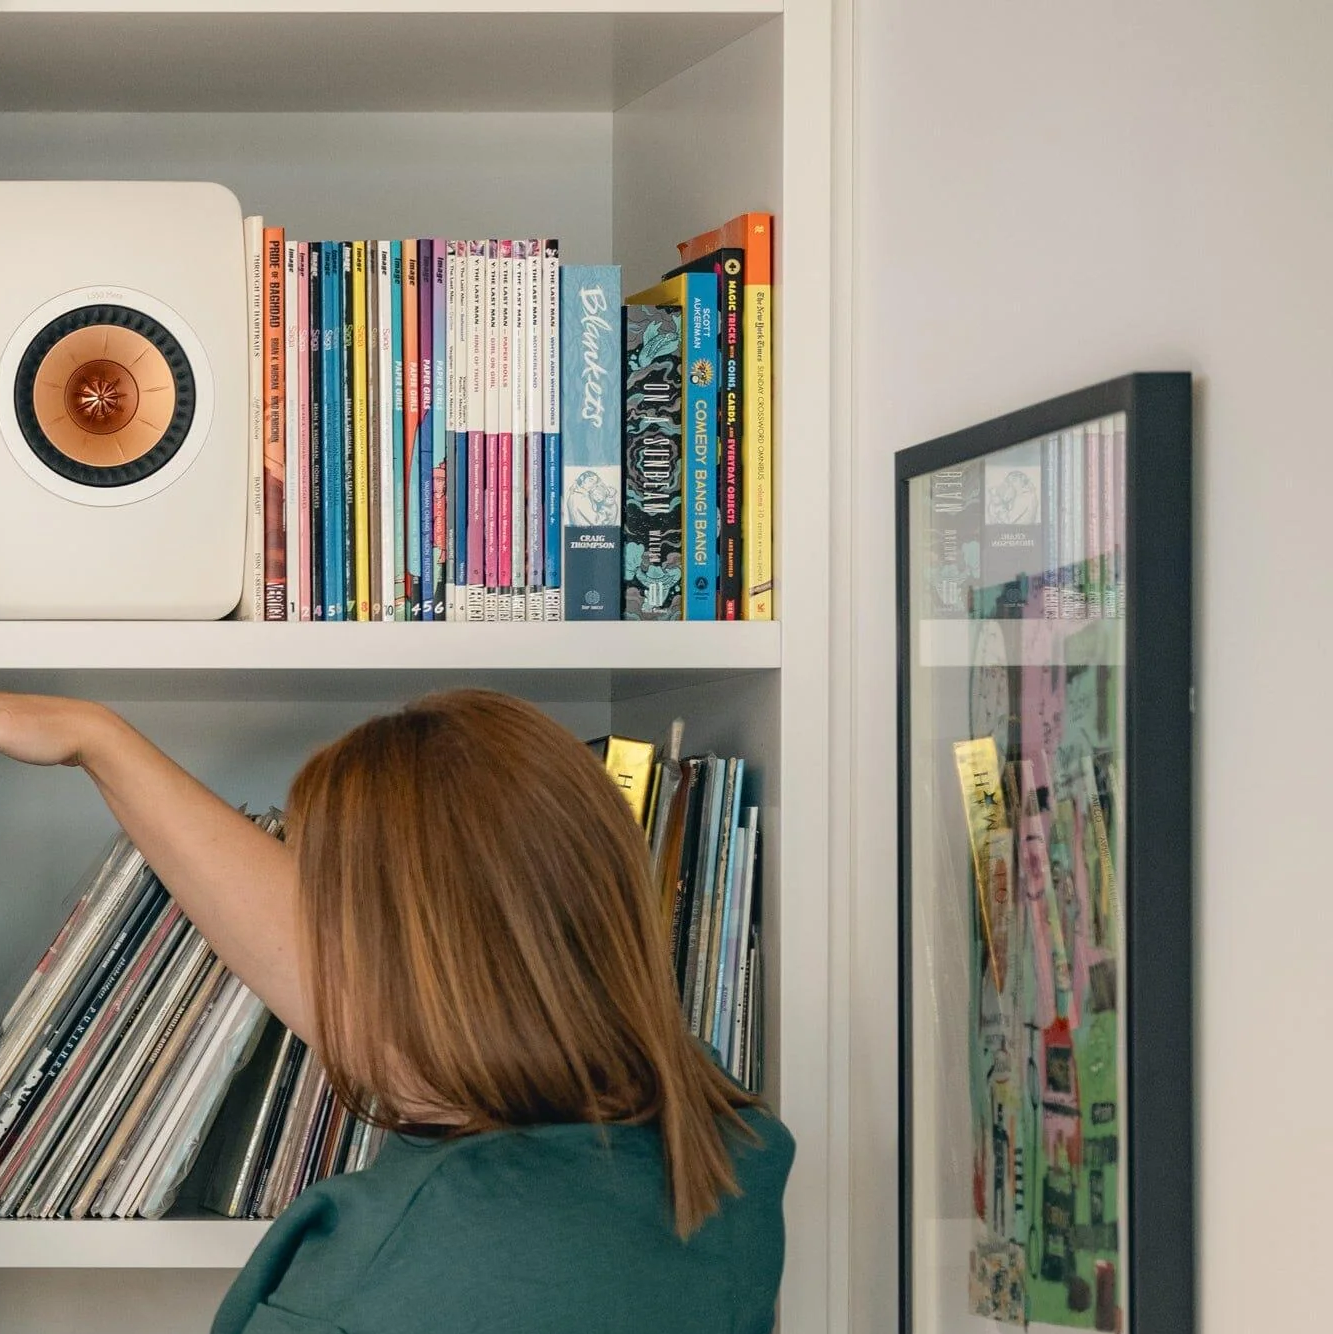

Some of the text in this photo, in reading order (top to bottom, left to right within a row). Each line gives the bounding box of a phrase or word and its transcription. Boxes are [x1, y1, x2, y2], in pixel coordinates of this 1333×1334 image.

[269, 240, 280, 269] PRIDE
[269, 282, 280, 328] BAGHDAD
[728, 280, 737, 311] MAGIC
[693, 297, 701, 349] AUKERMAN
[728, 312, 737, 345] TRICKS
[578, 285, 614, 429] Blankets
[643, 383, 670, 402] ON
[643, 438, 670, 514] SUNBEAM
[695, 400, 708, 566] COMEDY BANG! BANG!
[727, 439, 736, 485] EVERYDAY
[727, 486, 735, 524] OBJECTS
